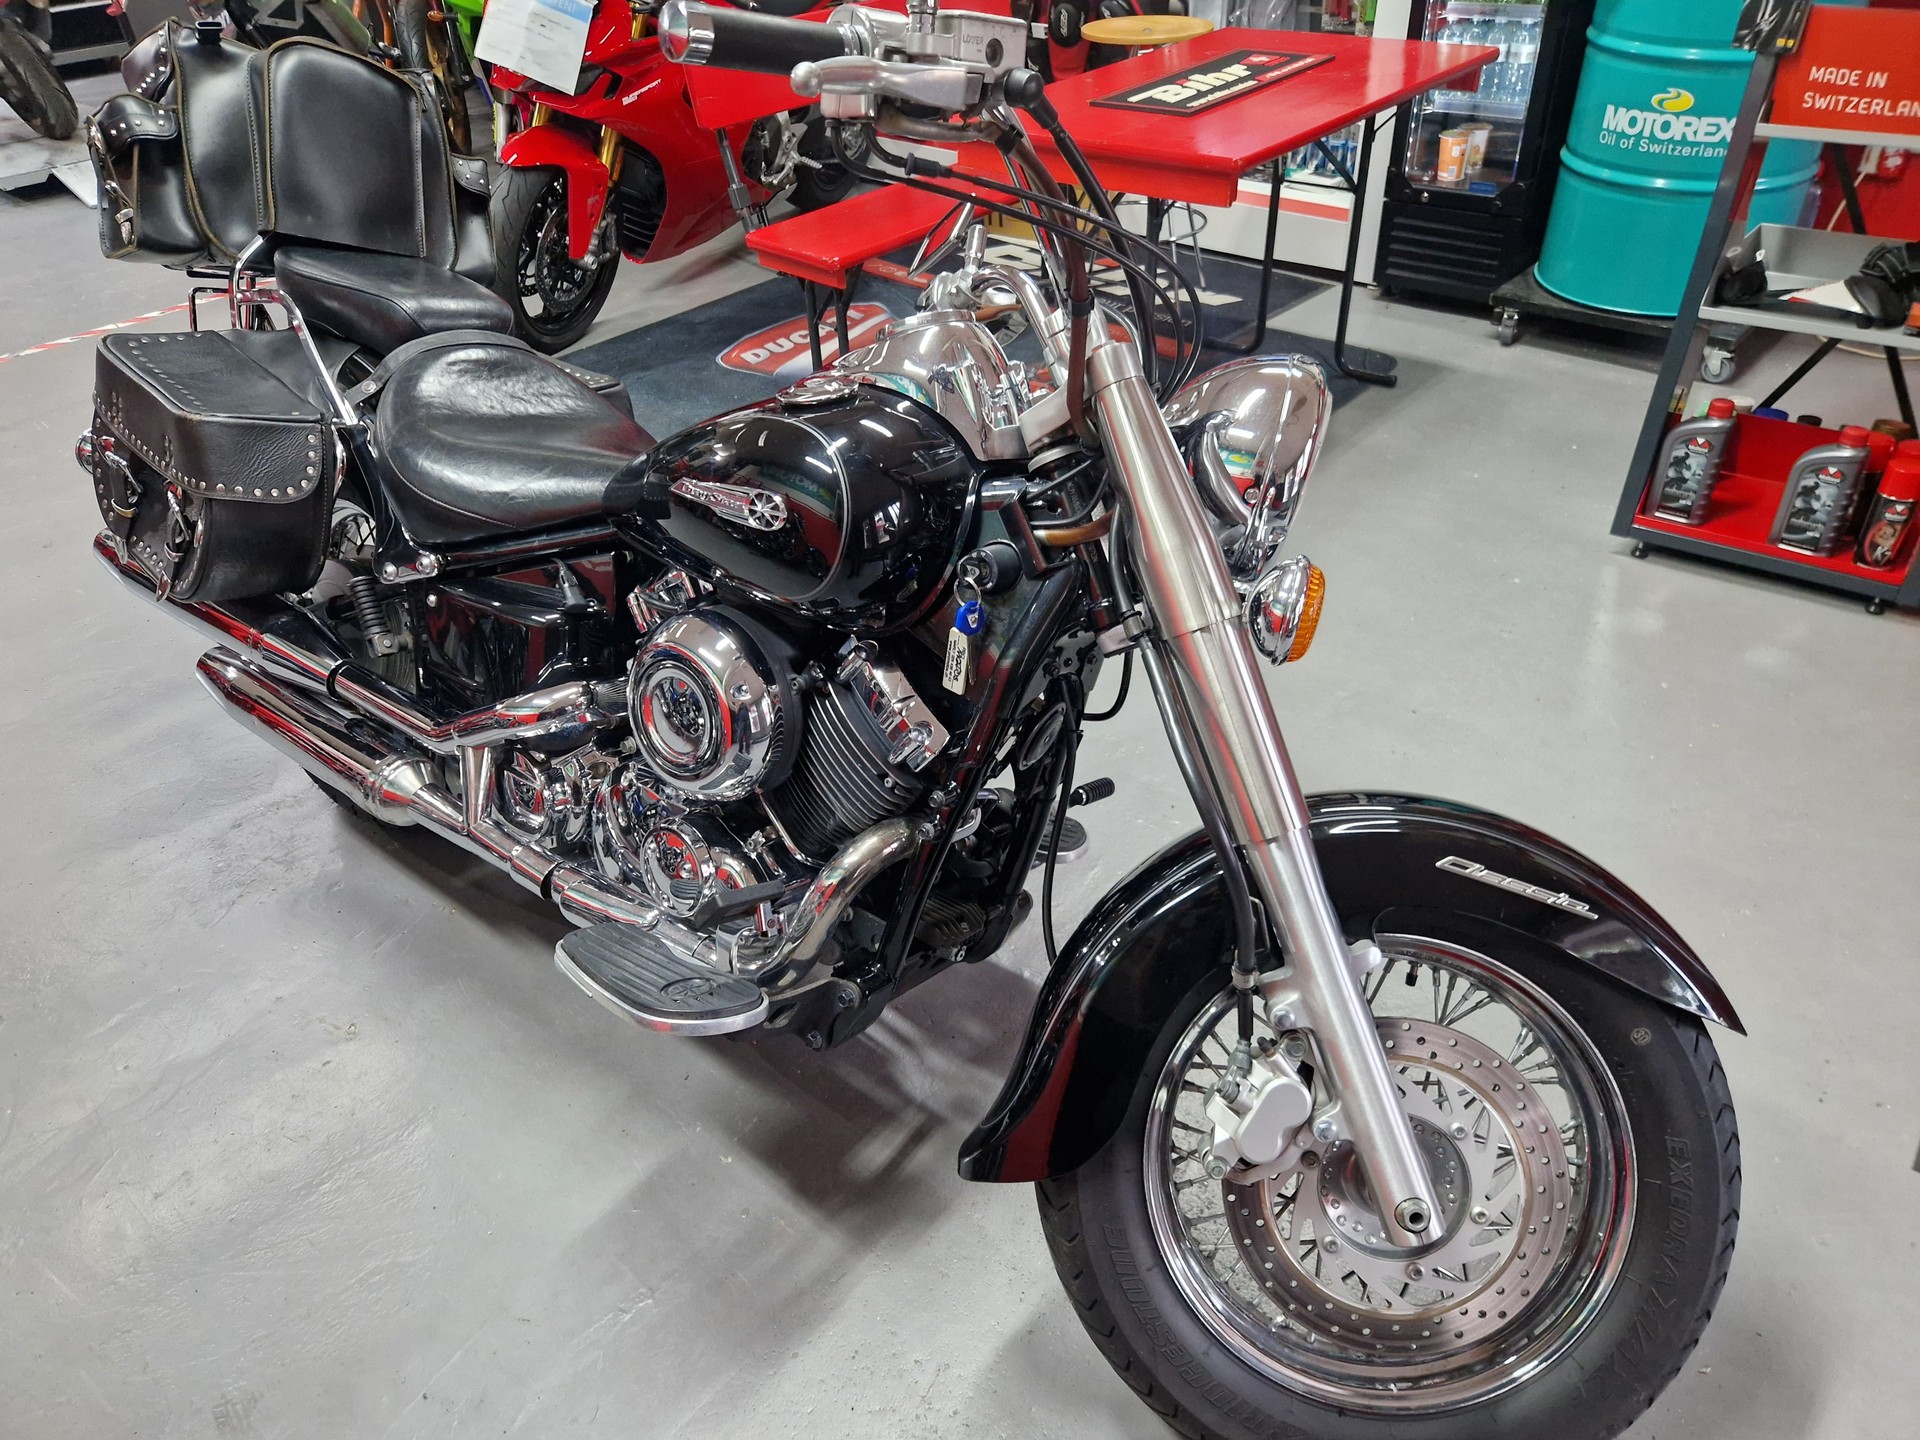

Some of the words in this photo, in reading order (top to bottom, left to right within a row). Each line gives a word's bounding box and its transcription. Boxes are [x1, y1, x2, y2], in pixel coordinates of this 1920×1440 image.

[962, 34, 984, 46] LOWER
[1127, 63, 1252, 103] Bihr
[1808, 66, 1862, 87] MADE
[1865, 71, 1889, 88] IN
[1802, 91, 1920, 118] SWITZERLAN
[1602, 104, 1737, 142] MOTOREX
[1599, 130, 1616, 146] Oil
[1620, 137, 1635, 149] of
